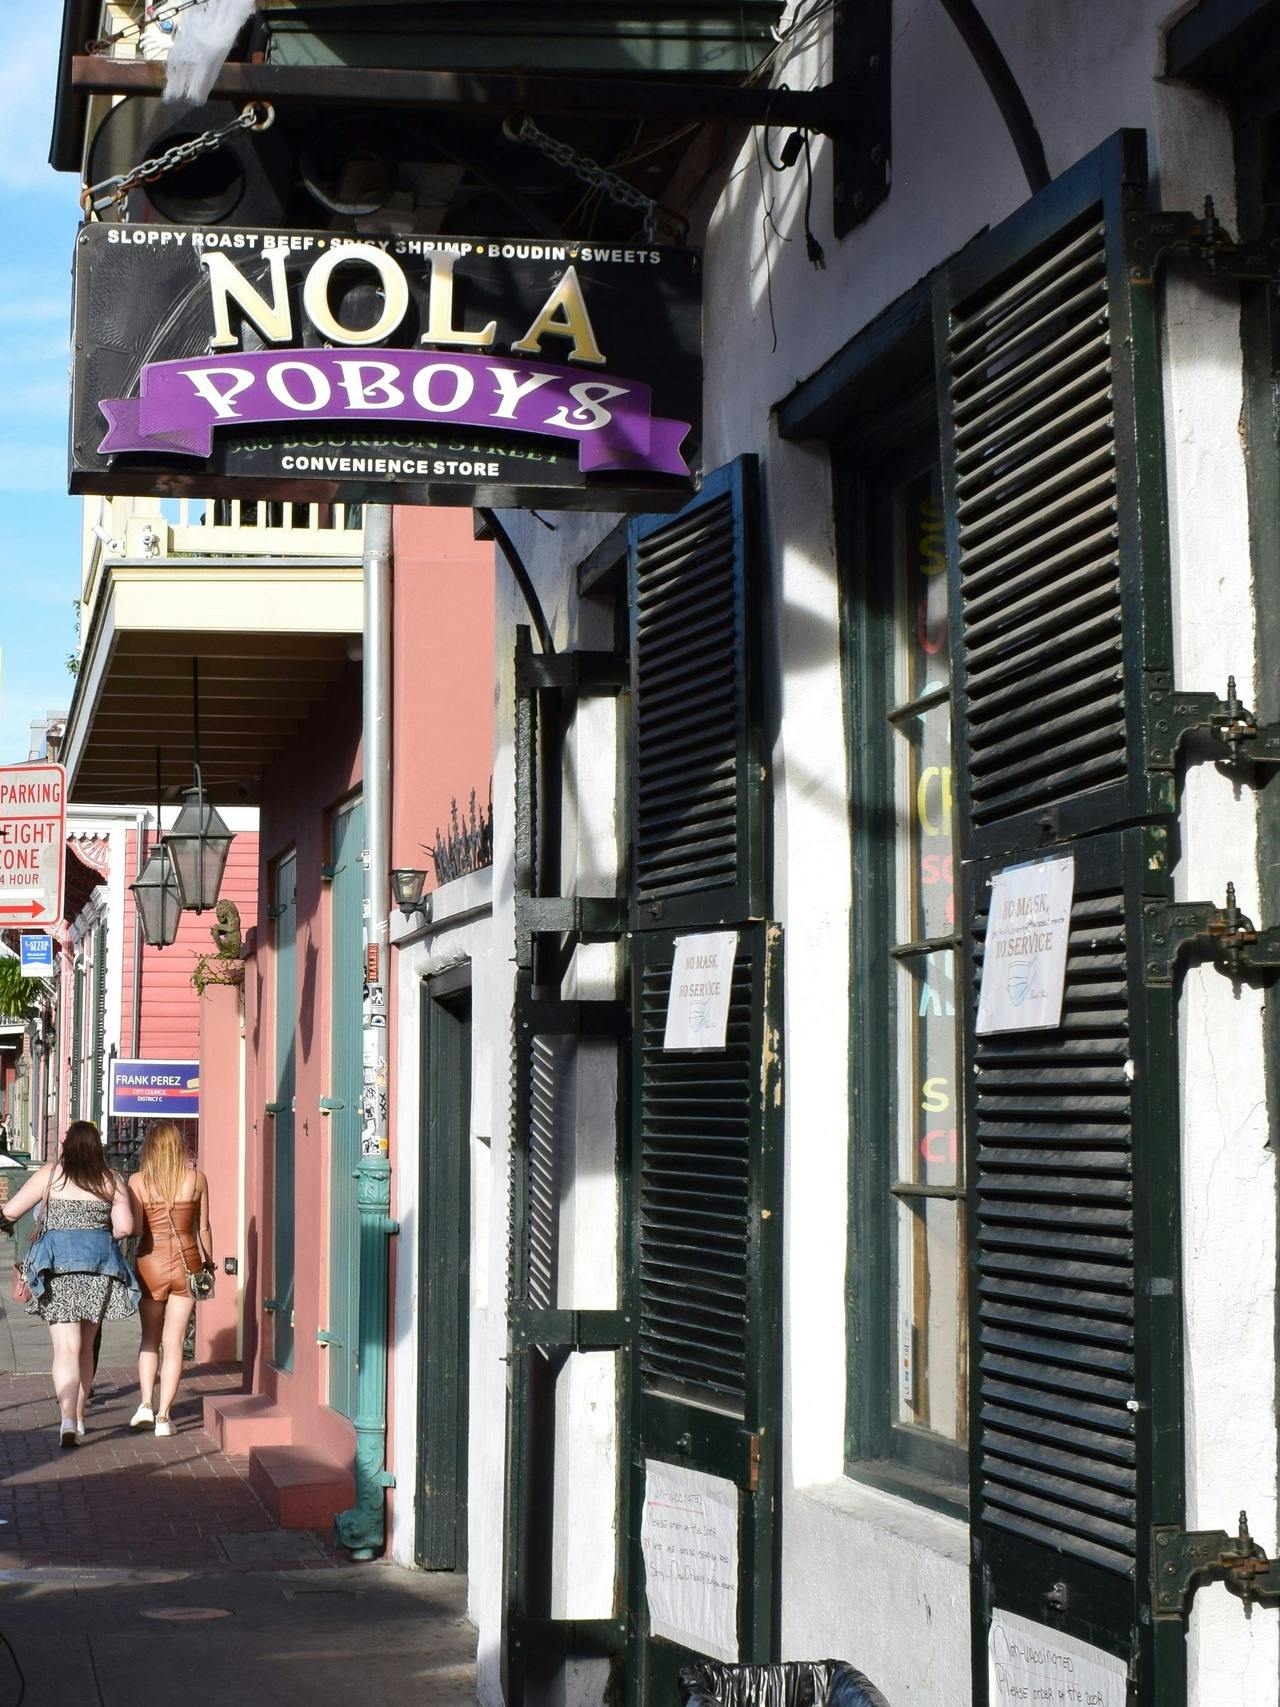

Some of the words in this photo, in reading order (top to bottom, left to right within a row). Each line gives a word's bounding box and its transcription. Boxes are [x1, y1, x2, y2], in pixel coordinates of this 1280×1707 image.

[107, 230, 187, 245] SLOPPY
[192, 232, 258, 248] ROAST
[264, 235, 314, 250] BEEF
[488, 244, 565, 260] BOUDIN
[581, 248, 661, 264] SWEETS
[200, 245, 607, 364] NOLA
[178, 360, 630, 432] POBOYS
[281, 456, 428, 475] CONVENIENCE
[433, 461, 499, 476] STORE
[1, 783, 61, 804] PARKING
[10, 873, 39, 885] HOUR
[1007, 932, 1053, 957] SERVICE
[689, 982, 721, 997] SERVICE
[116, 1074, 149, 1085] FRANK
[150, 1076, 181, 1086] PEREZ
